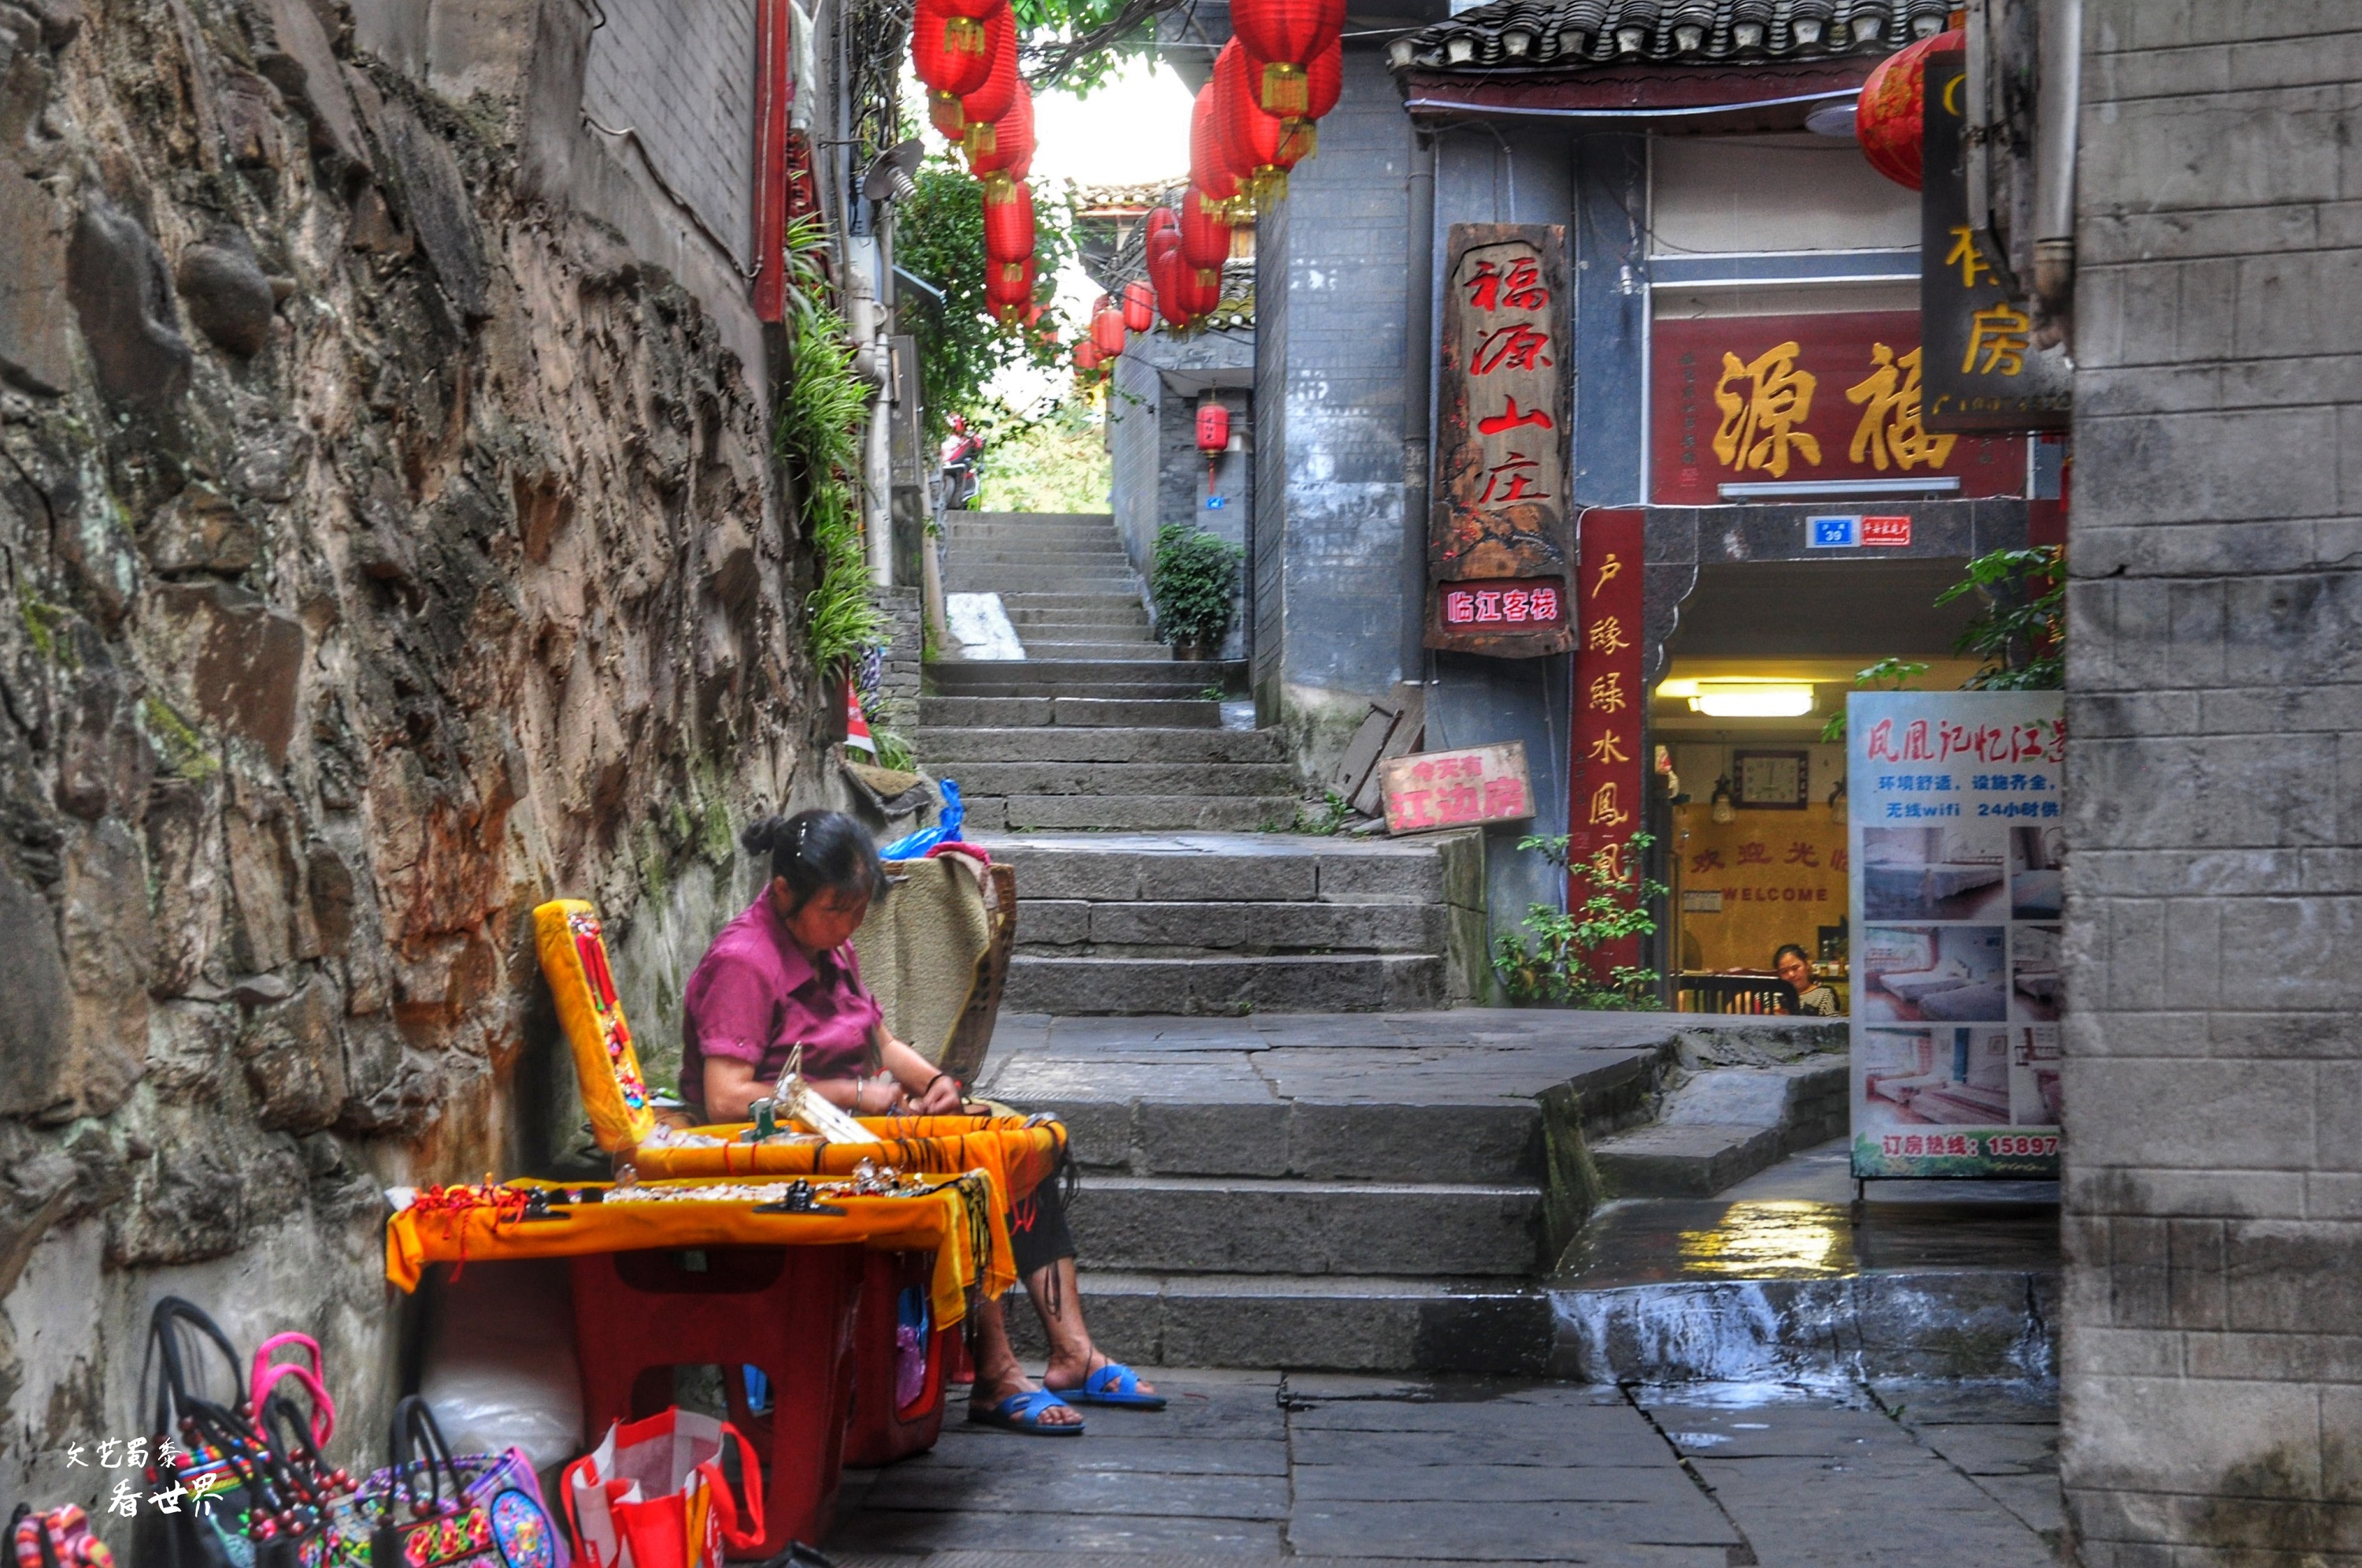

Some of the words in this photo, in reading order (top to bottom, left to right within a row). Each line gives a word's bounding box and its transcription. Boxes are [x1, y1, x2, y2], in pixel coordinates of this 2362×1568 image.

[1463, 257, 1553, 505] 福源山庄
[1825, 530, 1842, 542] 39
[1447, 589, 1558, 623] 临江客栈
[1412, 756, 1483, 782] 今天有
[1390, 777, 1525, 830] 江边房
[1886, 802, 1960, 819] 无线wifi
[1722, 887, 1828, 902] WELCOME
